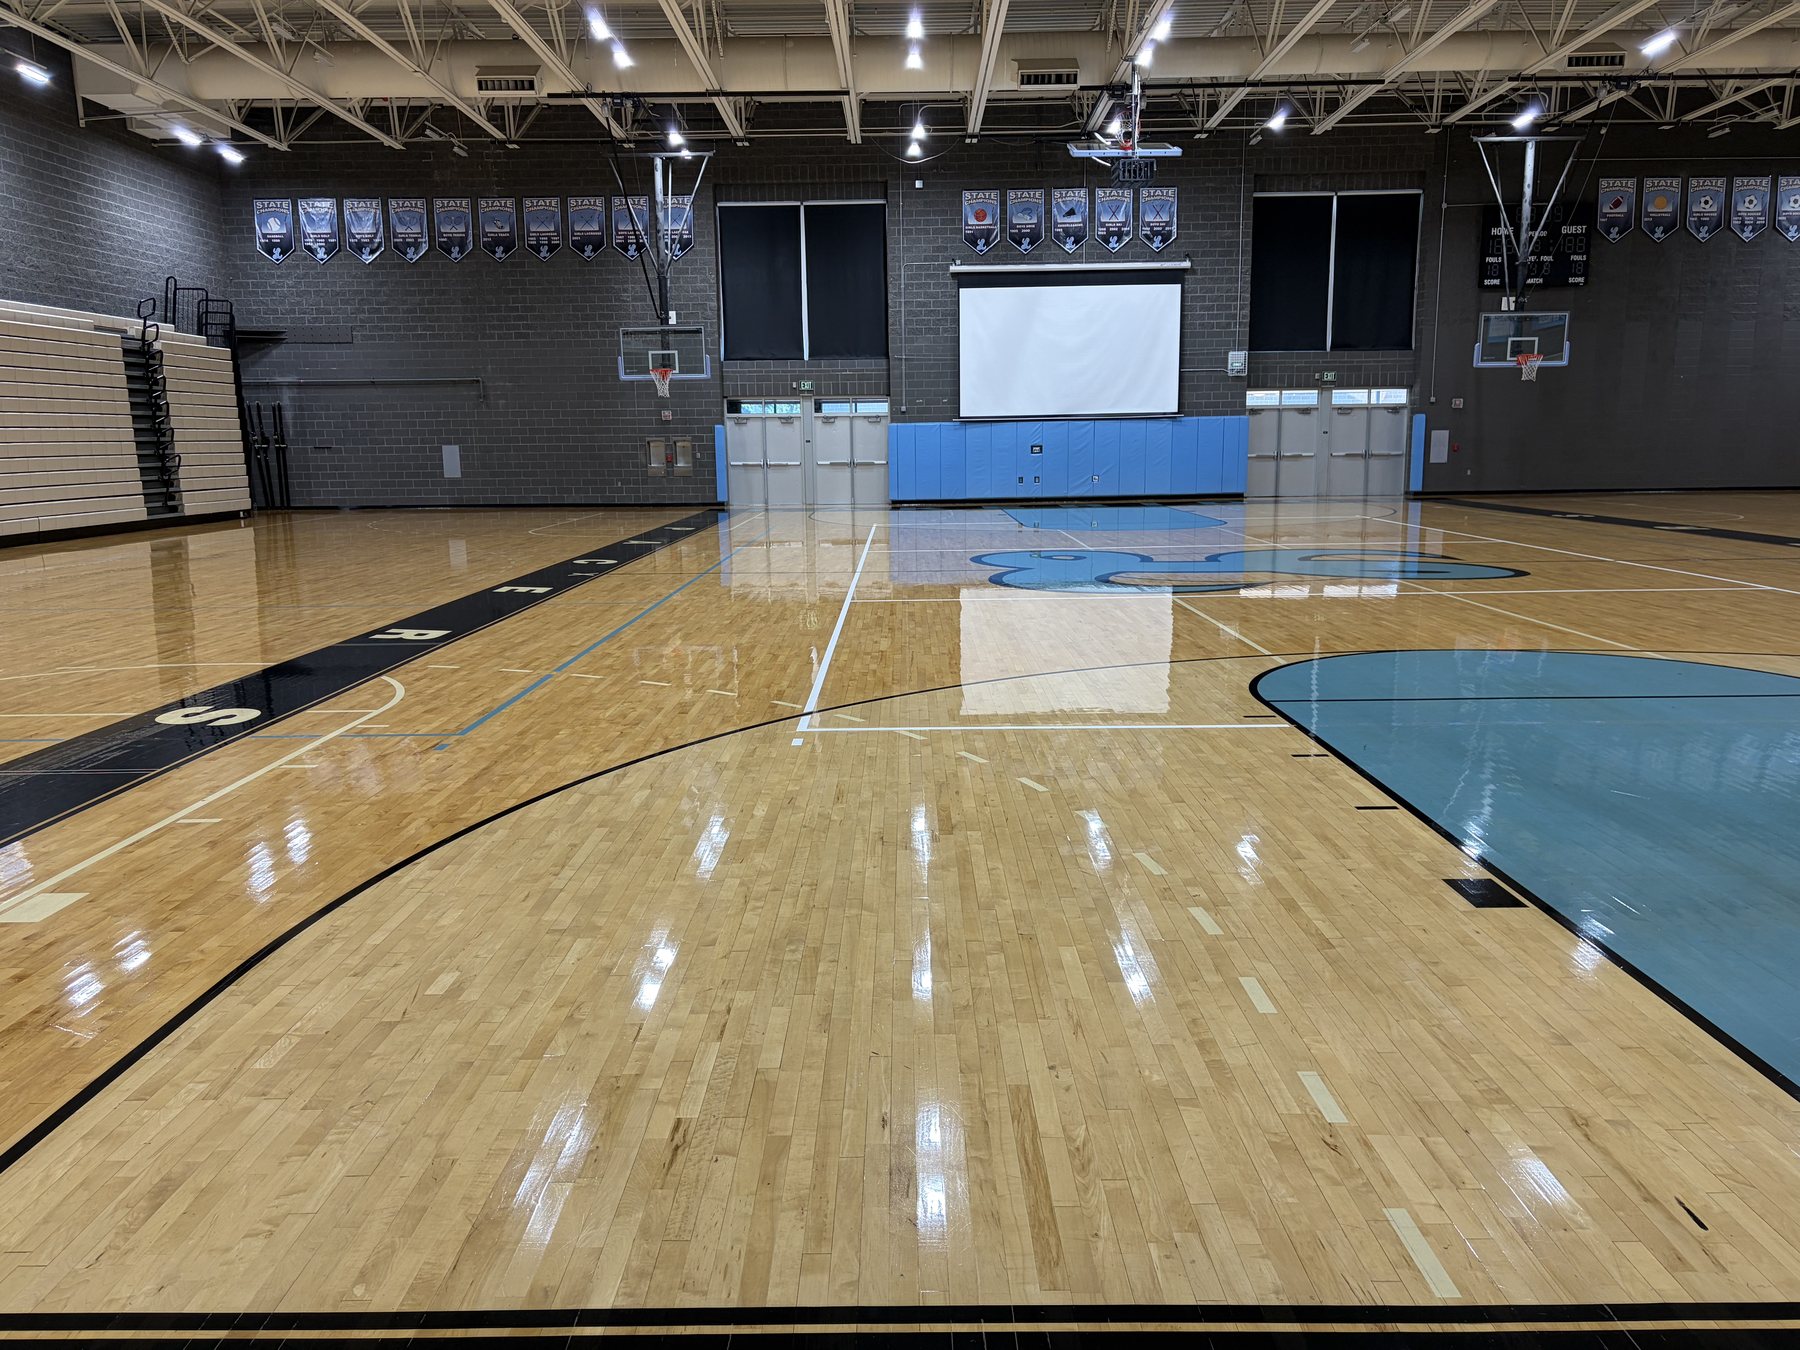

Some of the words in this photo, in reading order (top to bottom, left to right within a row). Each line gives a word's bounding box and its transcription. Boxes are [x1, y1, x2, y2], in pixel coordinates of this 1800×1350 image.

[965, 192, 997, 200] STATE
[436, 200, 468, 208] STATE
[481, 200, 513, 208] STATE
[525, 199, 558, 207] STATE
[570, 199, 602, 207] STATE
[1562, 225, 1587, 234] GUEST
[1324, 372, 1335, 380] EXIT
[801, 381, 812, 389] EXIT
